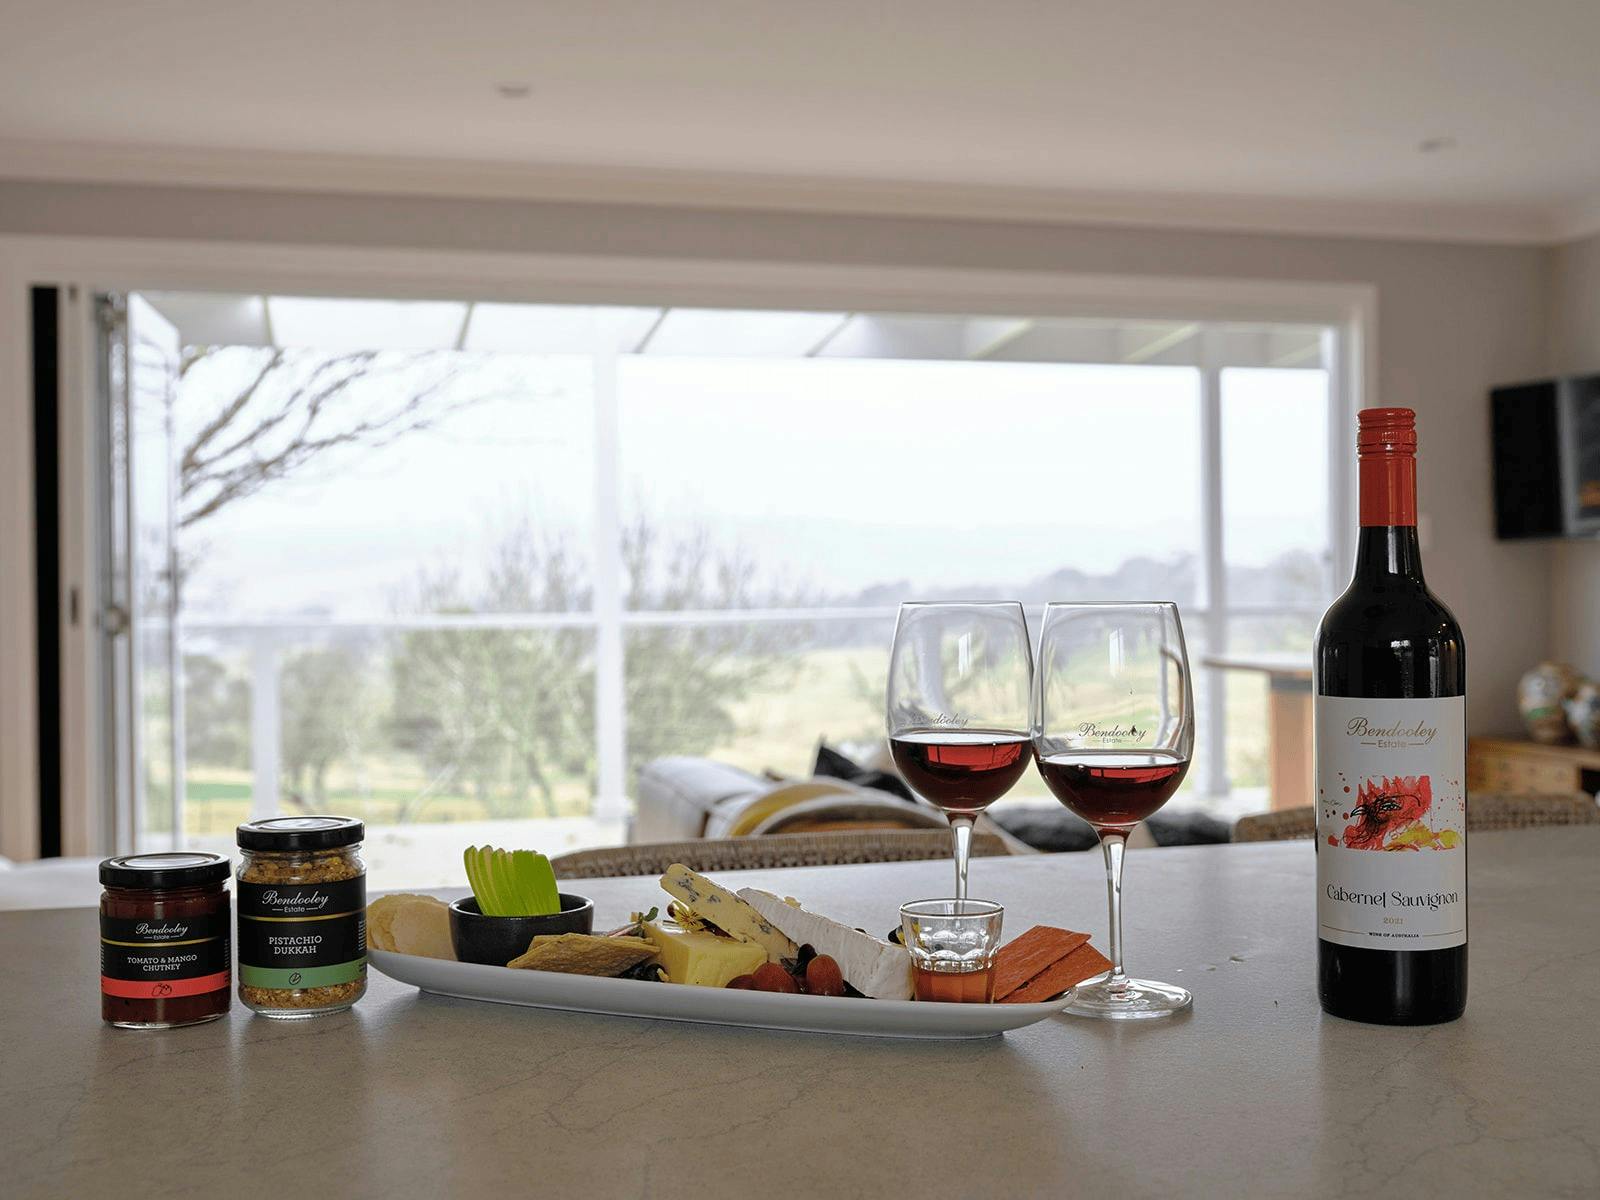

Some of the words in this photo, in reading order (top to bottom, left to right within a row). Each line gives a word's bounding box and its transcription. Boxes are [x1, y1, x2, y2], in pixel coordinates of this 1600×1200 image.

[1347, 716, 1437, 745] Bendooley
[1377, 739, 1408, 748] Estate
[262, 889, 329, 909] Bendooley
[1326, 884, 1386, 908] Cabernet
[1391, 890, 1458, 911] Sauvignon
[135, 922, 189, 937] Bendooley
[268, 935, 323, 945] PISTACHIO
[274, 945, 317, 955] DUKKAH
[127, 956, 159, 964] TOMATO
[167, 954, 198, 963] MANGO
[142, 963, 181, 971] CHUTNEY
